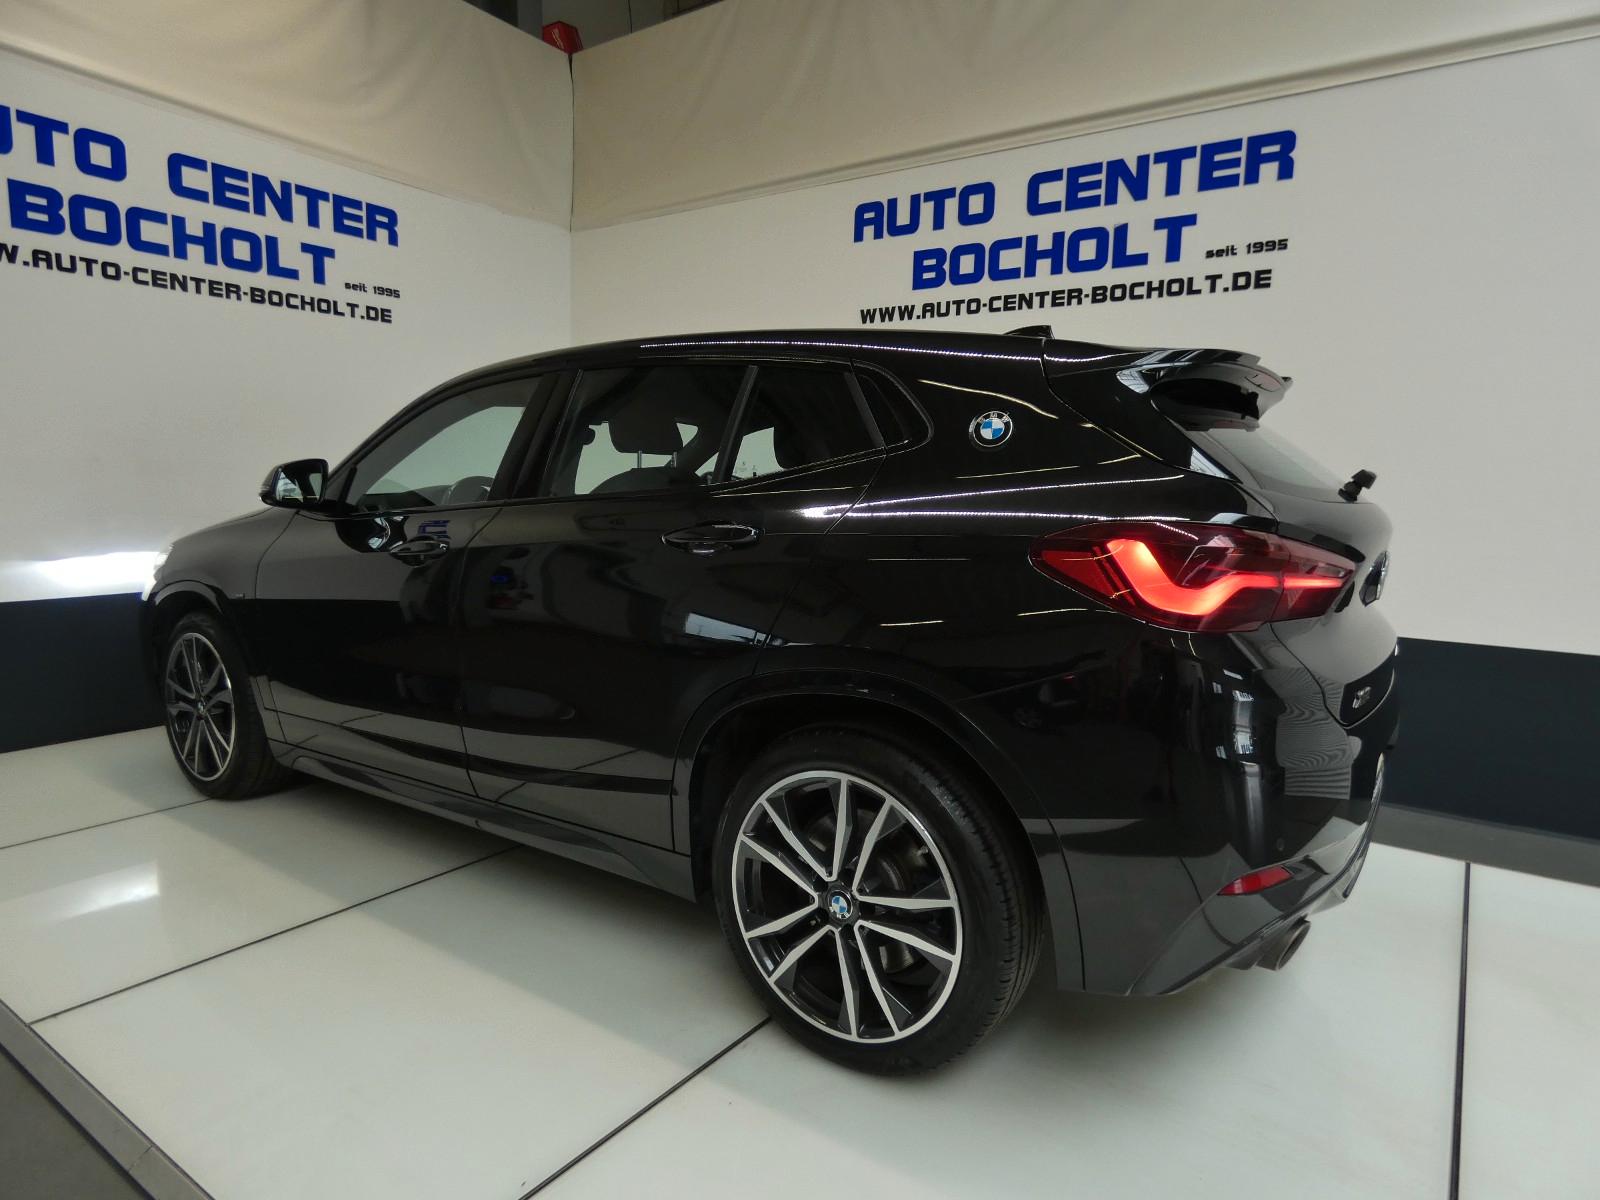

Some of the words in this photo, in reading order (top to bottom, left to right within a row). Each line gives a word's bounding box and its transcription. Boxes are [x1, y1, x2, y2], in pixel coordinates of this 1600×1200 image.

[0, 105, 127, 182] TO
[167, 152, 399, 246] CENTER
[854, 182, 996, 243] AUTO
[1027, 130, 1297, 216] CENTER
[7, 178, 336, 285] BOCHOLT
[344, 282, 368, 293] seit
[372, 285, 401, 299] 1995
[912, 213, 1198, 290] BOCHOLT
[1205, 244, 1238, 259] seit
[1246, 239, 1289, 255] 1995
[860, 269, 1273, 325] WWW.AUTO-CENTER-BOCHOLT.DE
